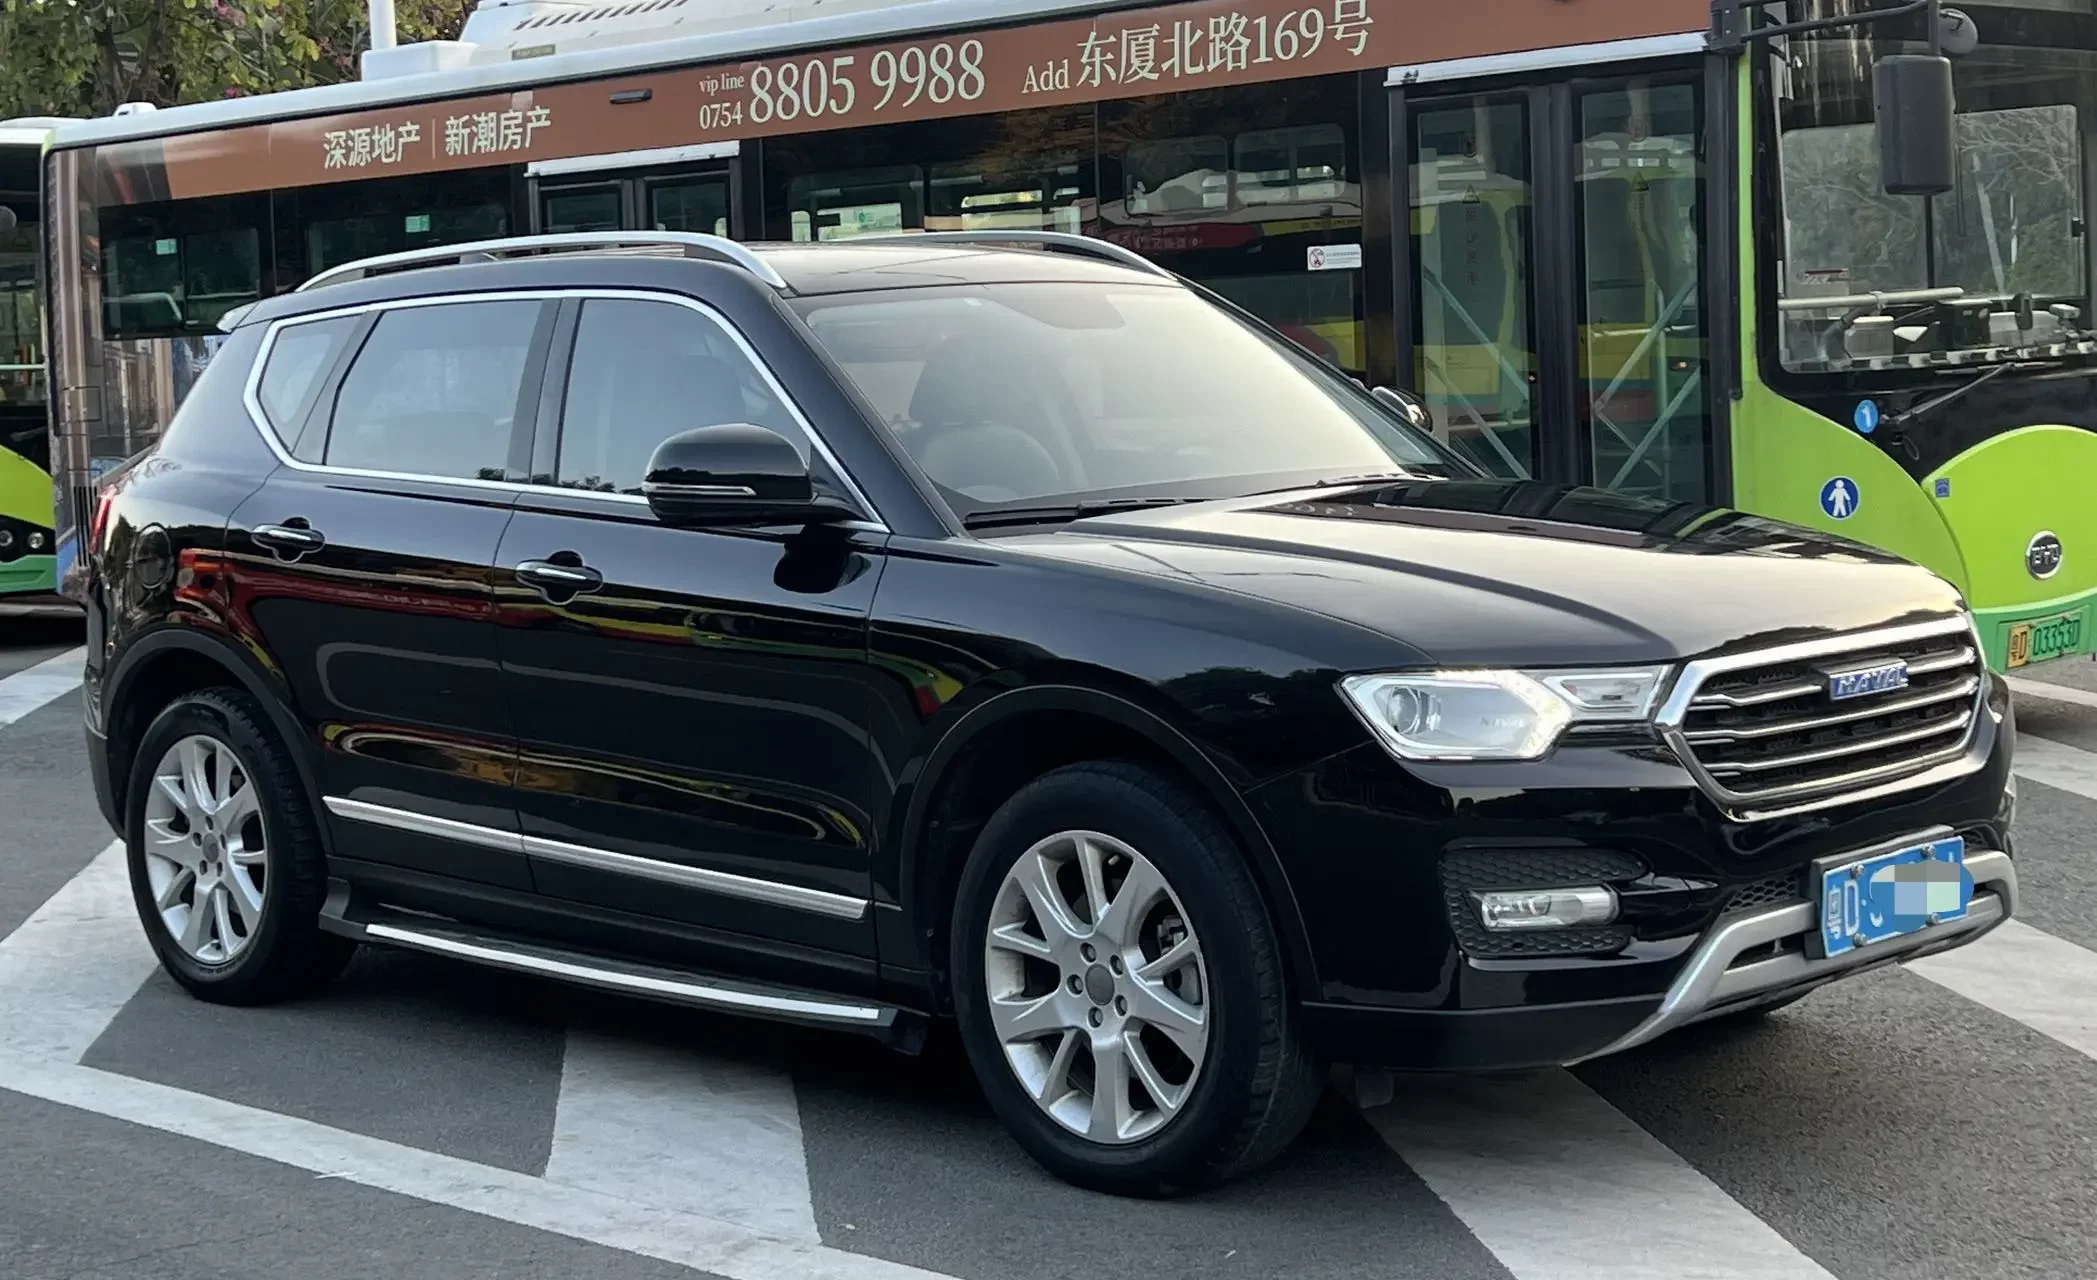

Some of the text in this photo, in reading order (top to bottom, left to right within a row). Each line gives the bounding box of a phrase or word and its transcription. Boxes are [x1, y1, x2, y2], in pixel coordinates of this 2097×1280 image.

[1021, 0, 1374, 95] Add 东厦北路169号
[700, 72, 745, 97] vip line
[700, 39, 985, 130] 0754 8805 9988
[323, 105, 552, 169] 深源地产 新潮房产
[1836, 667, 1908, 695] HAVAL
